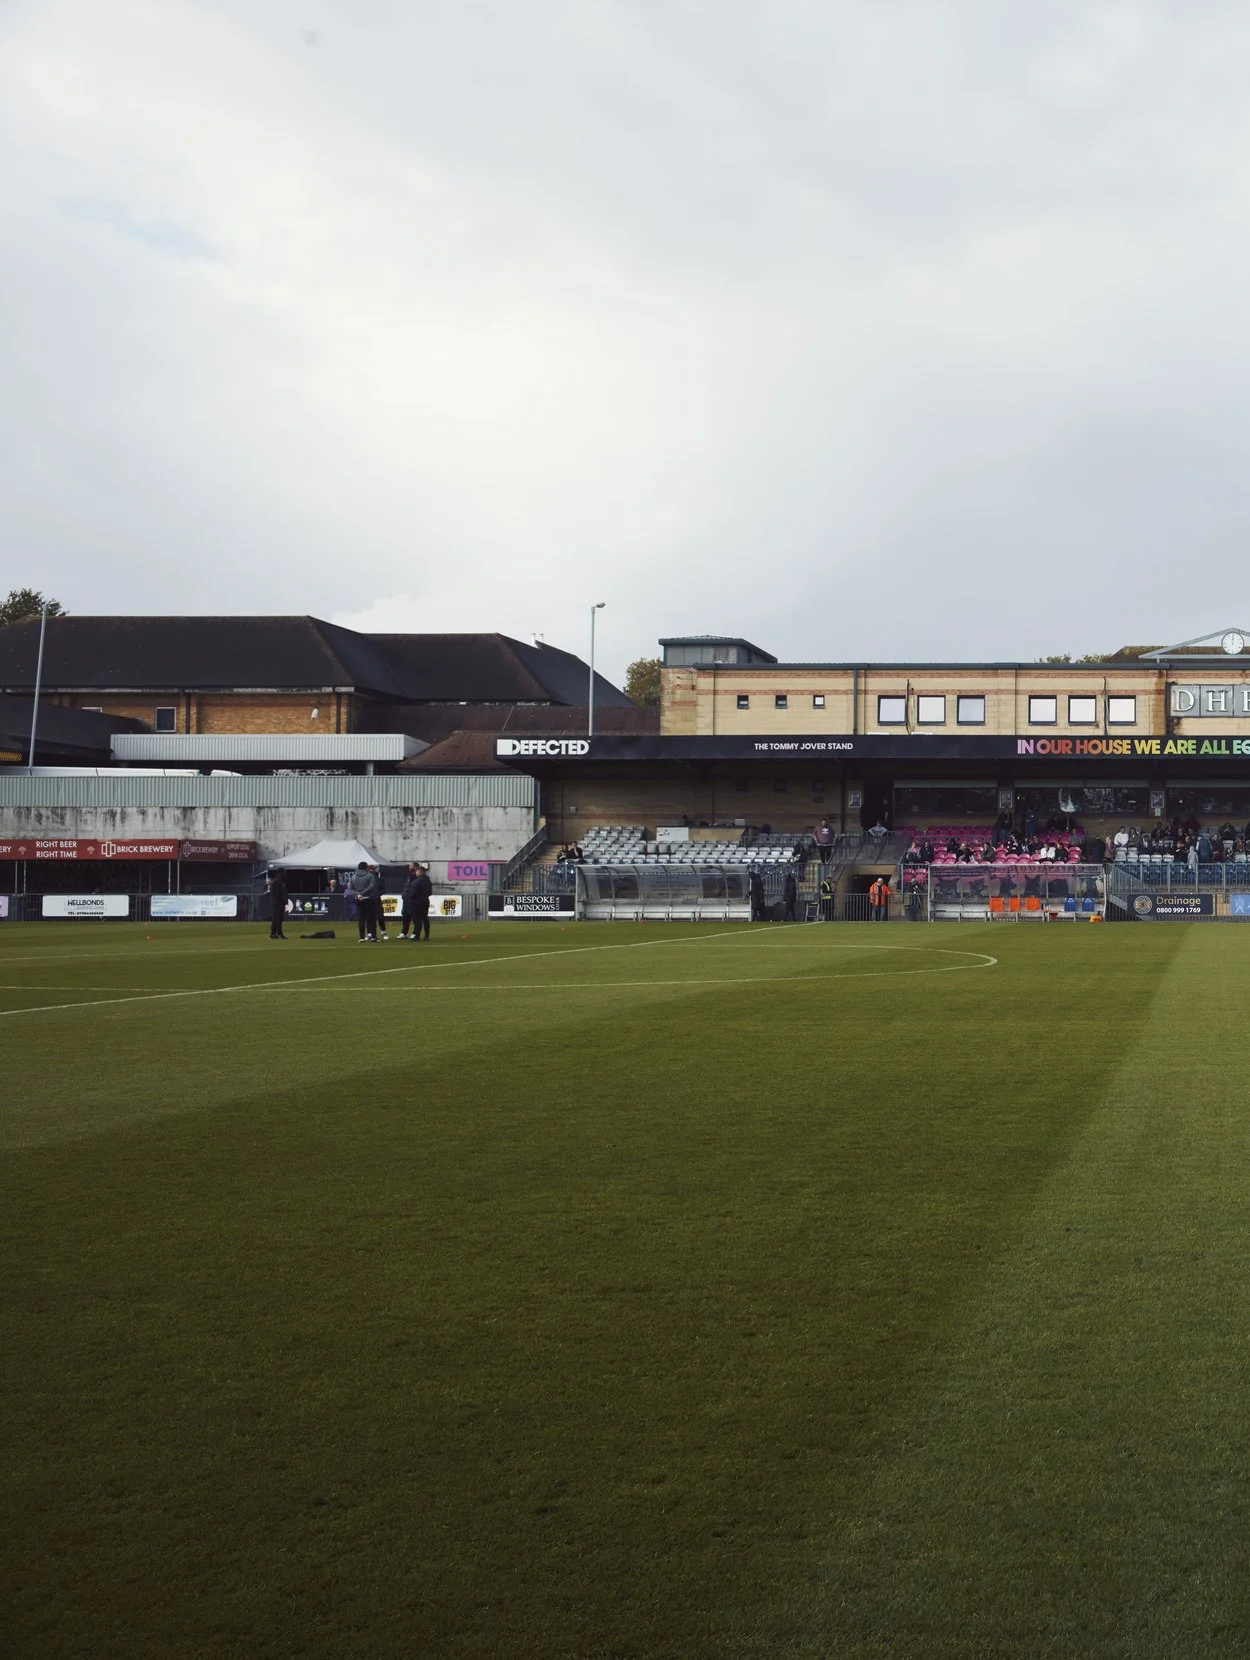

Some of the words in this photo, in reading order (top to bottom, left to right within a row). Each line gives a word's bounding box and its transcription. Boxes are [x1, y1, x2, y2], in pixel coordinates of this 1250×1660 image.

[497, 739, 590, 755] DEFECTED
[1017, 739, 1034, 754] IN
[1036, 739, 1072, 755] OUR
[1076, 739, 1131, 755] HOUSE
[1134, 739, 1160, 754] WE
[1163, 739, 1196, 754] ARE
[1200, 739, 1230, 754] ALL
[443, 900, 456, 909] BIG
[516, 896, 555, 904] BESPOKE
[1156, 896, 1201, 906] Drainage
